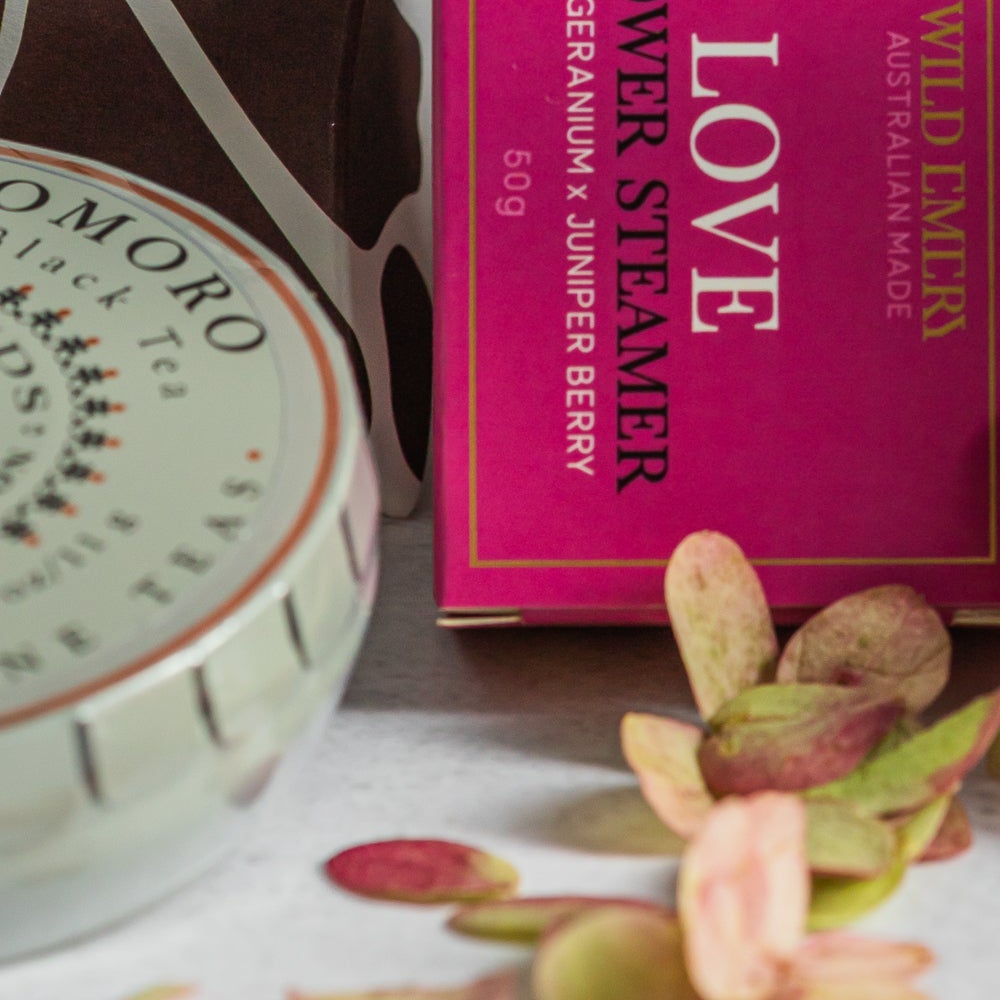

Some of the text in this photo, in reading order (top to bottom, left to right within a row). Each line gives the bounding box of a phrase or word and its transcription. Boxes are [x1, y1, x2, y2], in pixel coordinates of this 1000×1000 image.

[495, 149, 532, 217] 50g
[566, 183, 588, 201] x
[690, 32, 781, 333] LOVE
[886, 30, 911, 319] AUSTRALIAN MADE
[920, 0, 966, 342] WILD EMERY
[566, 213, 595, 353] JUNIPER
[615, 179, 669, 494] STEAMER
[137, 325, 188, 400] Tea
[566, 366, 595, 476] BERRY
